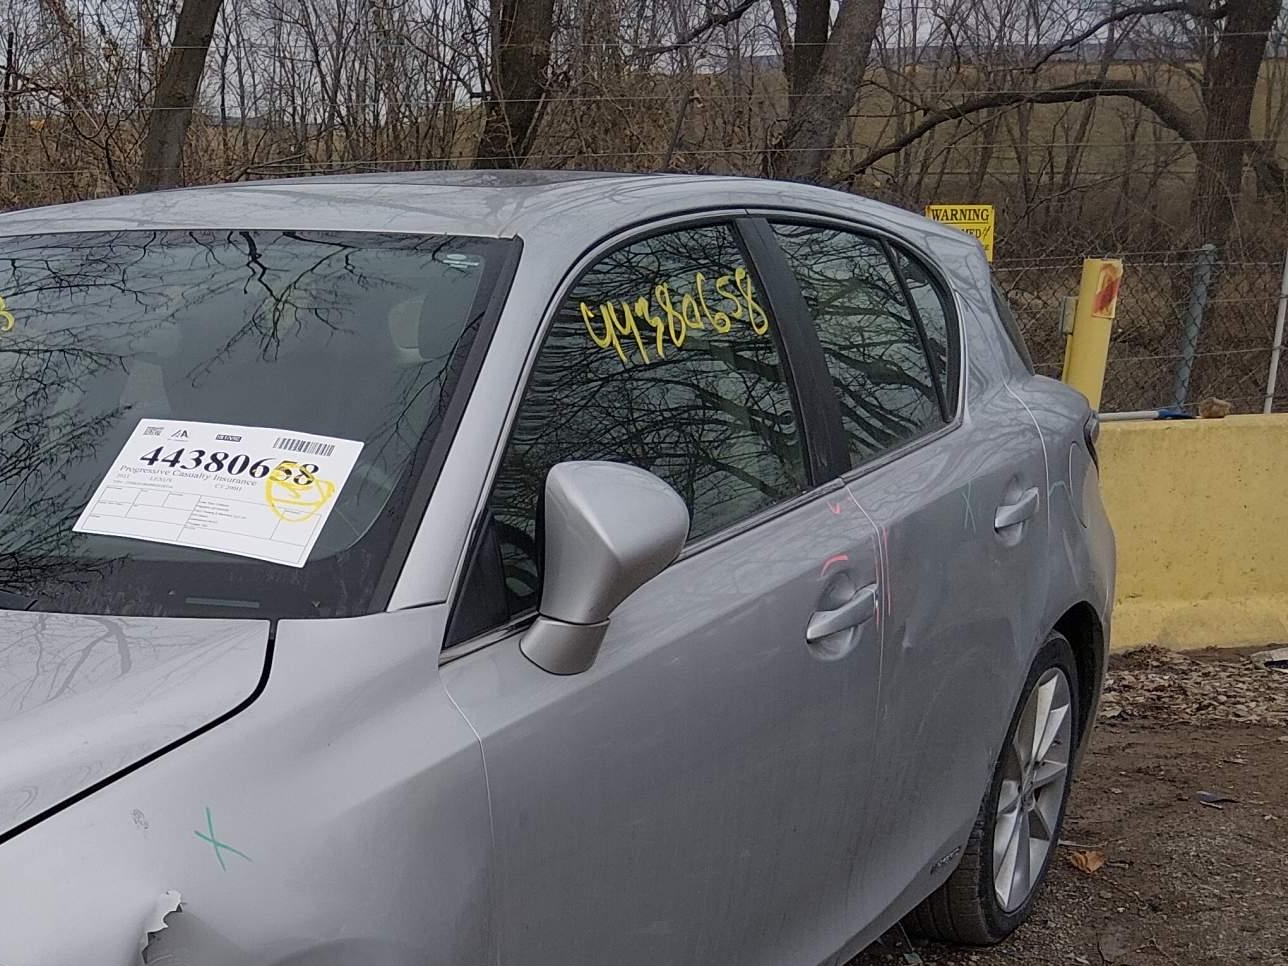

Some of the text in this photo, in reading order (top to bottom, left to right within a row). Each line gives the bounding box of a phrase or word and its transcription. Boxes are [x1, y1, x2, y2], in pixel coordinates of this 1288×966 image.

[931, 208, 990, 222] WARNING
[119, 464, 258, 486] Progressive Casualty Insurance
[139, 445, 320, 486] 44380658
